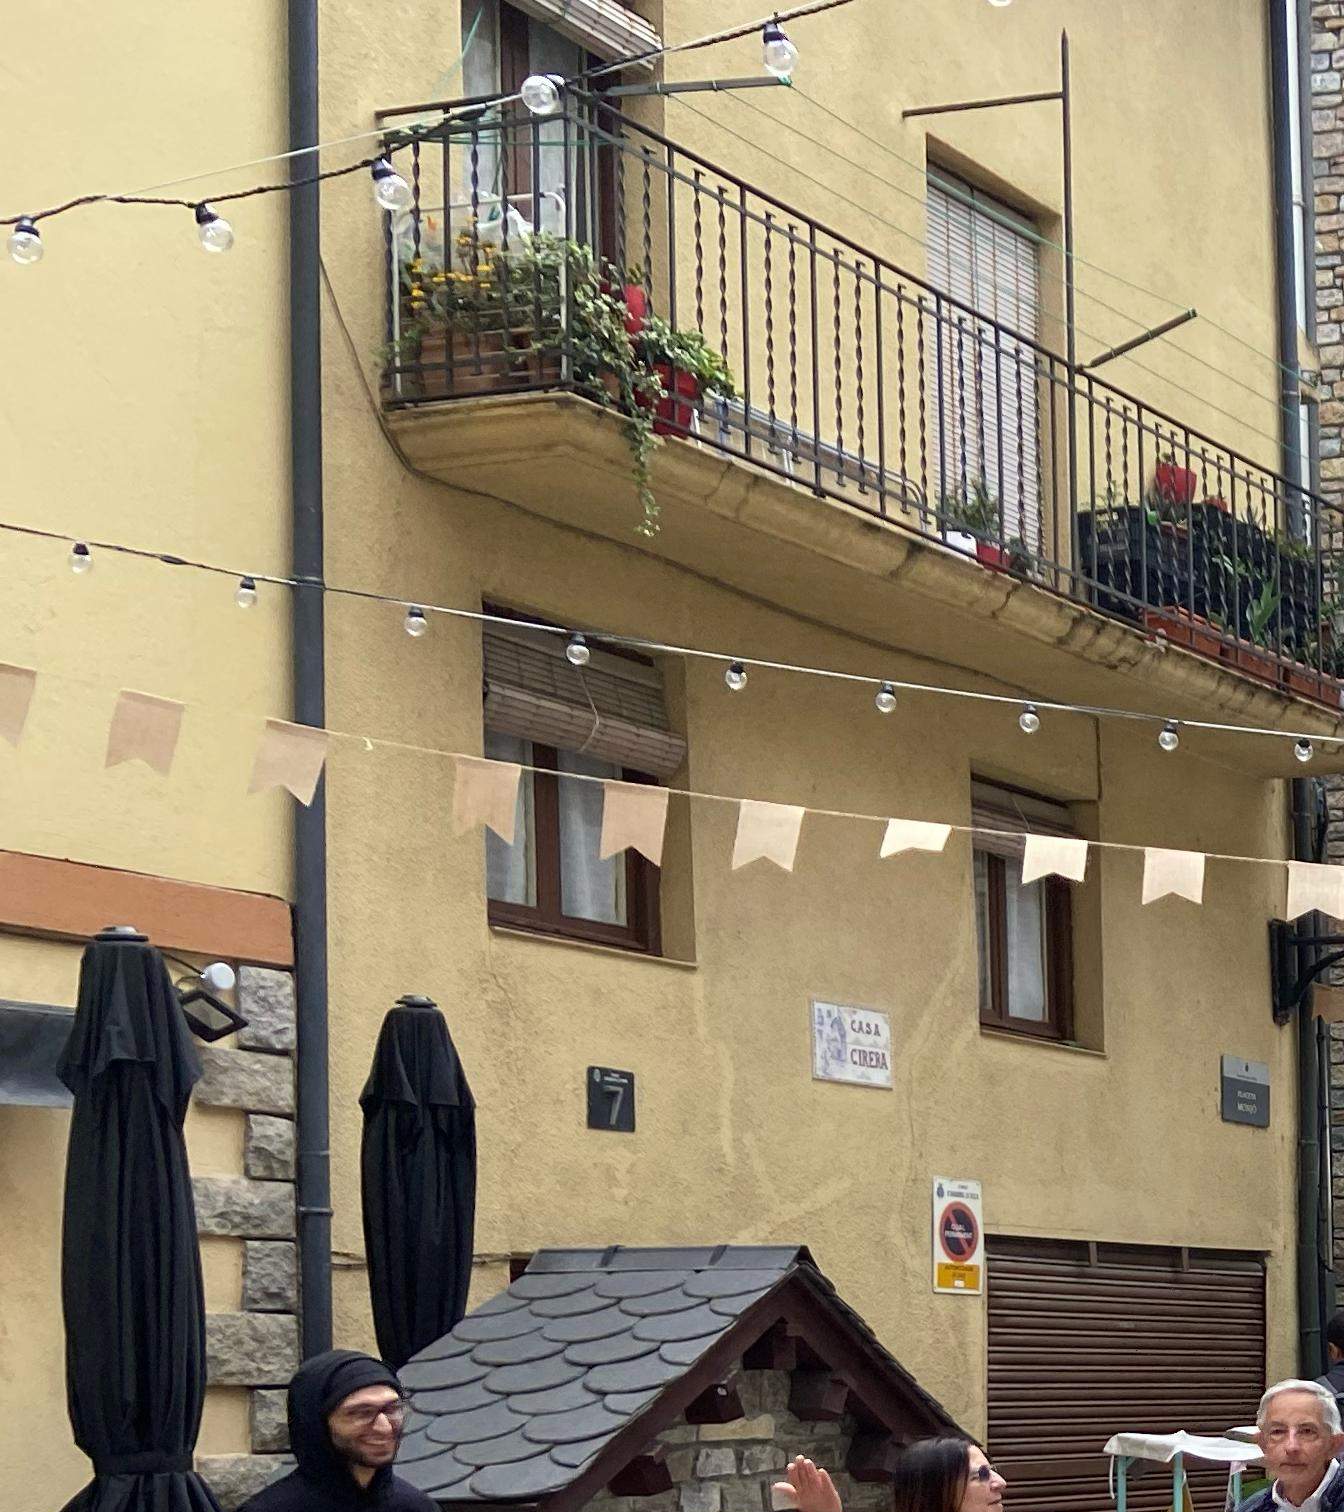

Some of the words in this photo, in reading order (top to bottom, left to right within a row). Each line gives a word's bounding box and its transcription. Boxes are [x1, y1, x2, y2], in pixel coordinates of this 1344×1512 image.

[850, 1019, 881, 1037] CASA
[850, 1048, 889, 1070] CIRERA
[603, 1085, 624, 1125] 7
